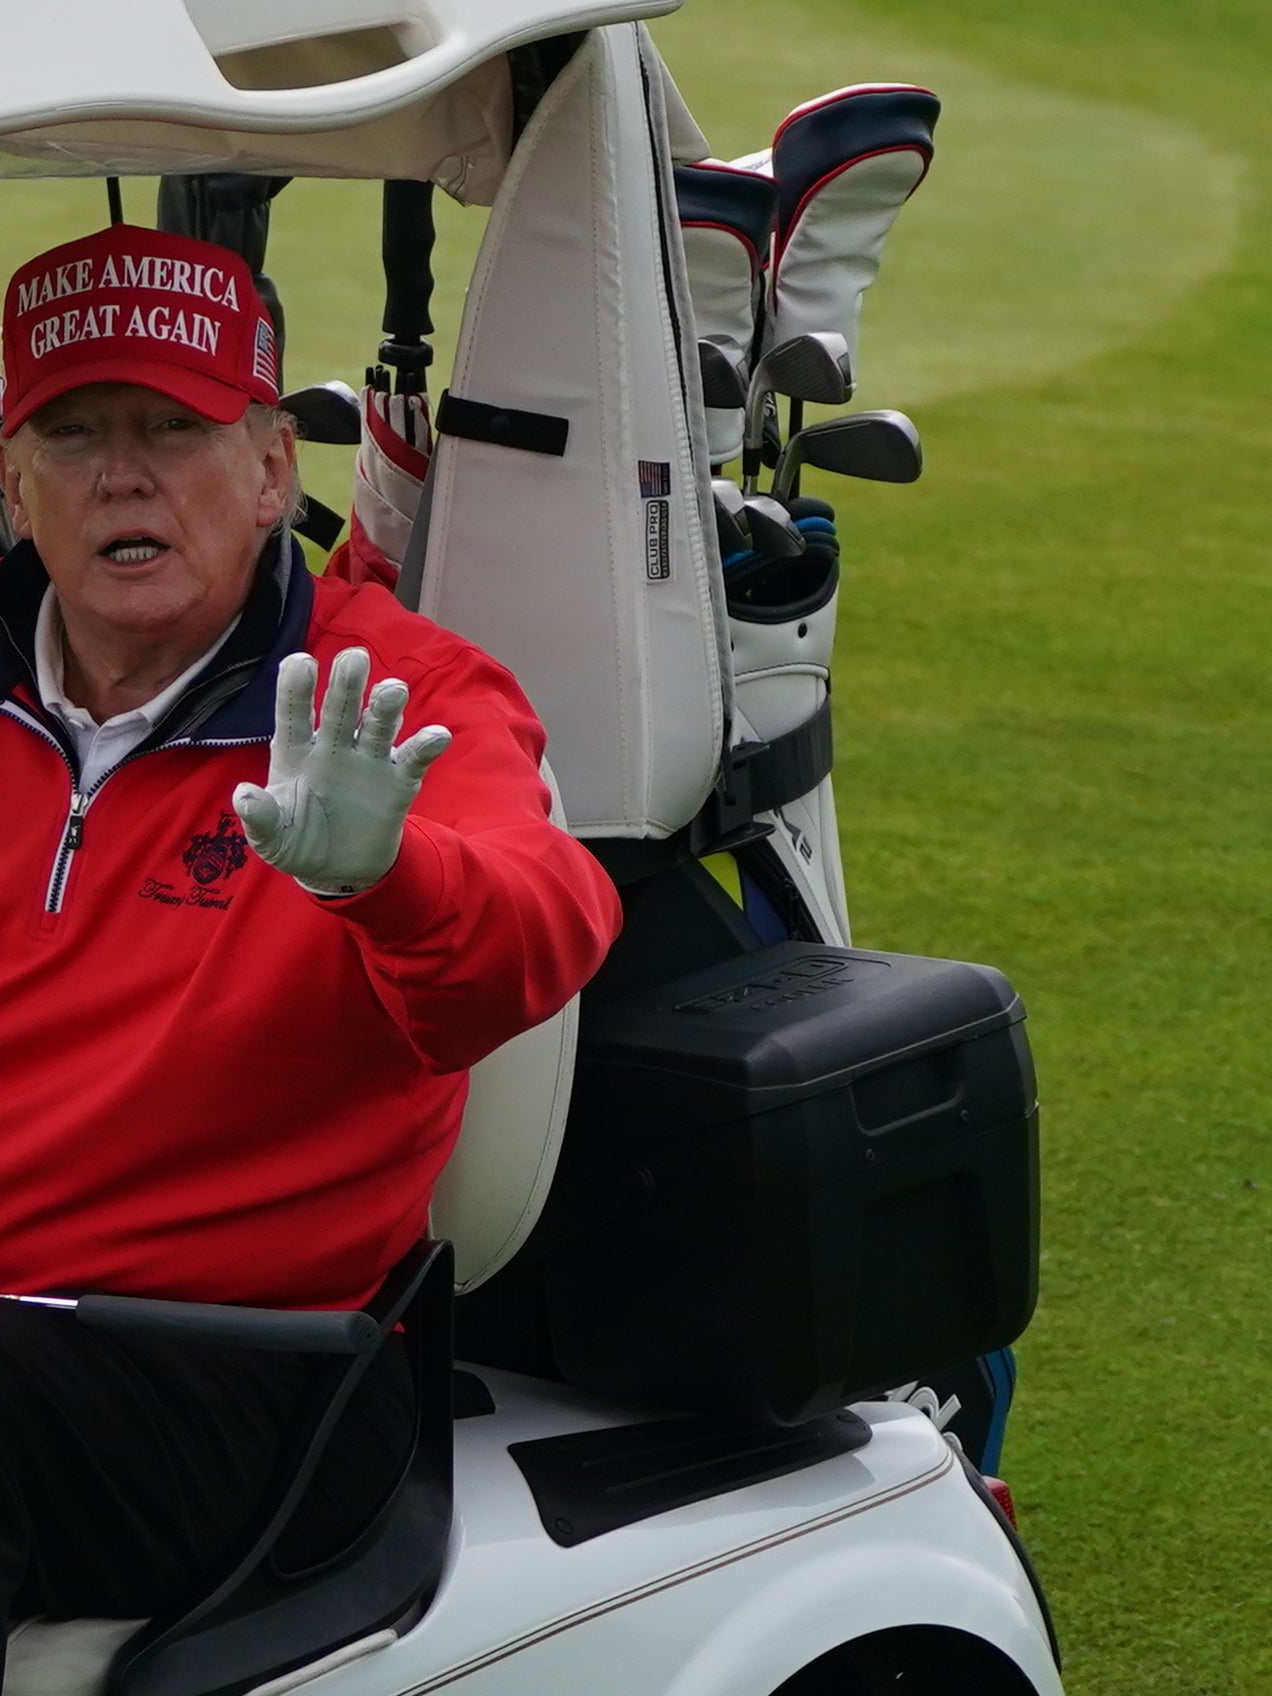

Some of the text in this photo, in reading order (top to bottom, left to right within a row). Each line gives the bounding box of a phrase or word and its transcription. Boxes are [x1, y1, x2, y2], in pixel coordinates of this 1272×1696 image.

[16, 254, 240, 317] MAKE AMERICA
[30, 305, 221, 359] GREAT AGAIN
[649, 504, 660, 576] CLUB PRO
